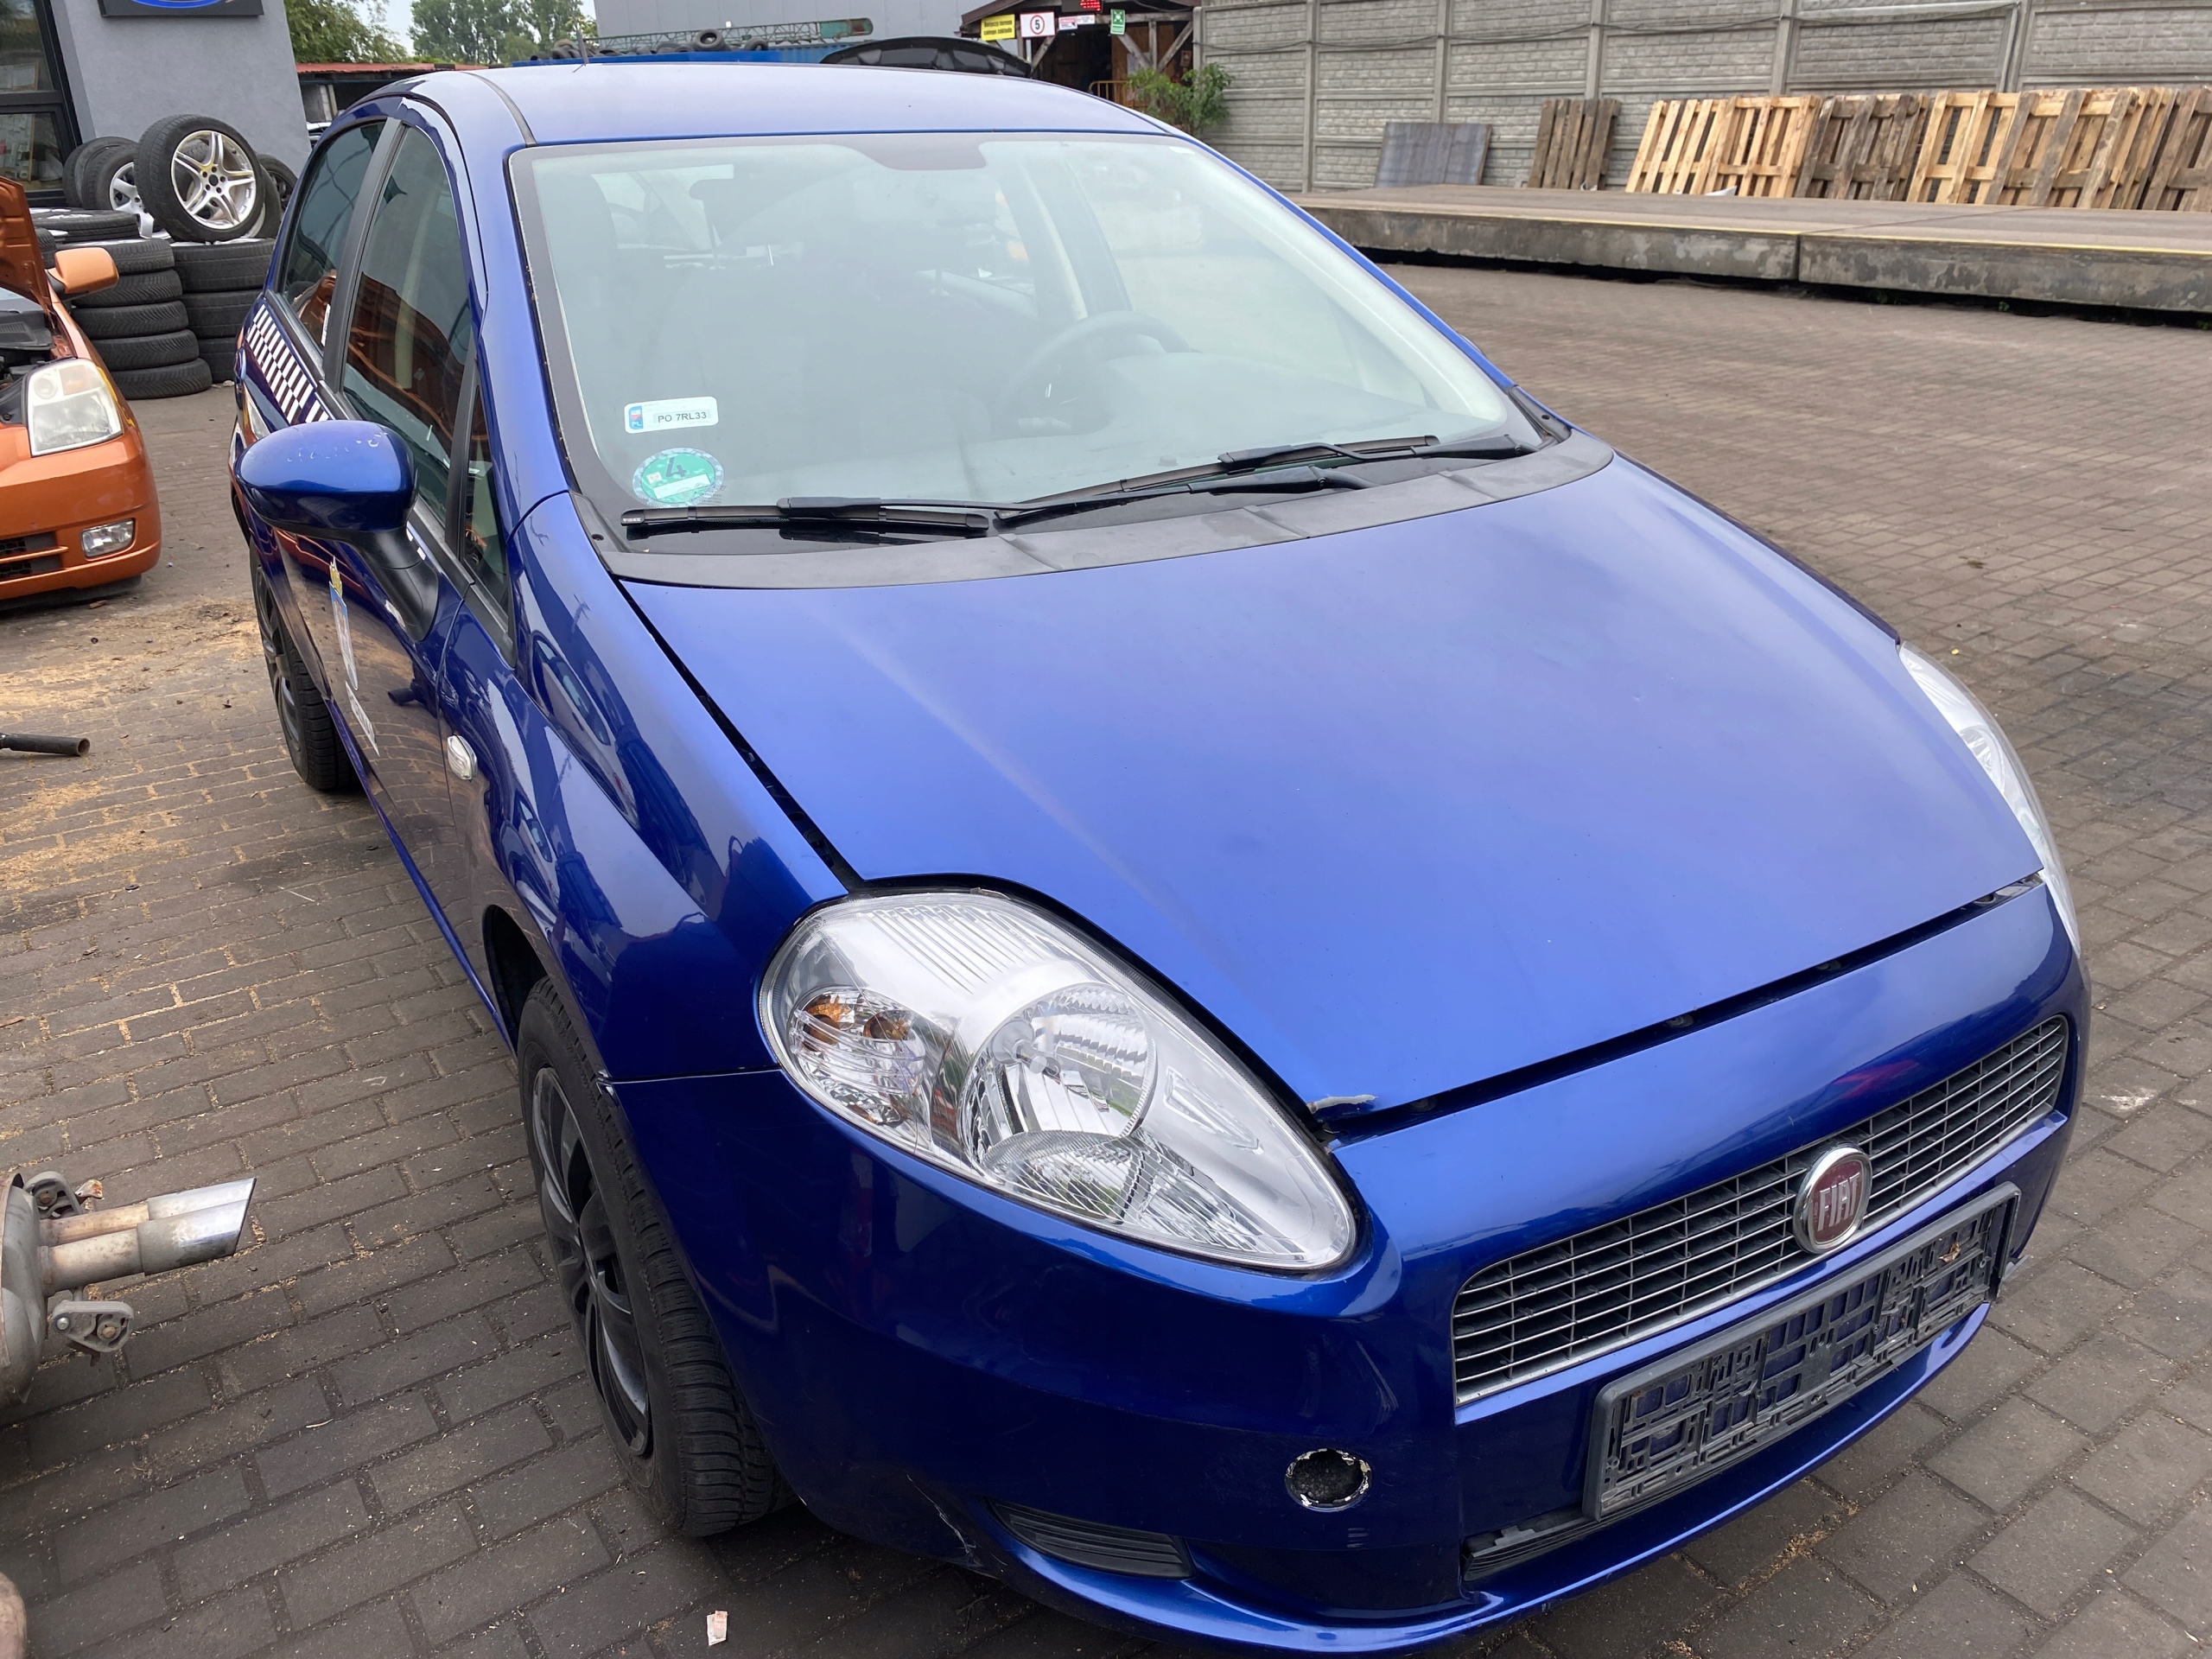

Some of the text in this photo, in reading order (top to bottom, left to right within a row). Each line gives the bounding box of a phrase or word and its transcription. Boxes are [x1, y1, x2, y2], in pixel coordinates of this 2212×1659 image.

[1035, 20, 1040, 29] 5
[658, 411, 707, 423] PO 7RL33
[665, 456, 686, 478] 4
[1817, 1172, 1861, 1232] FIAT
